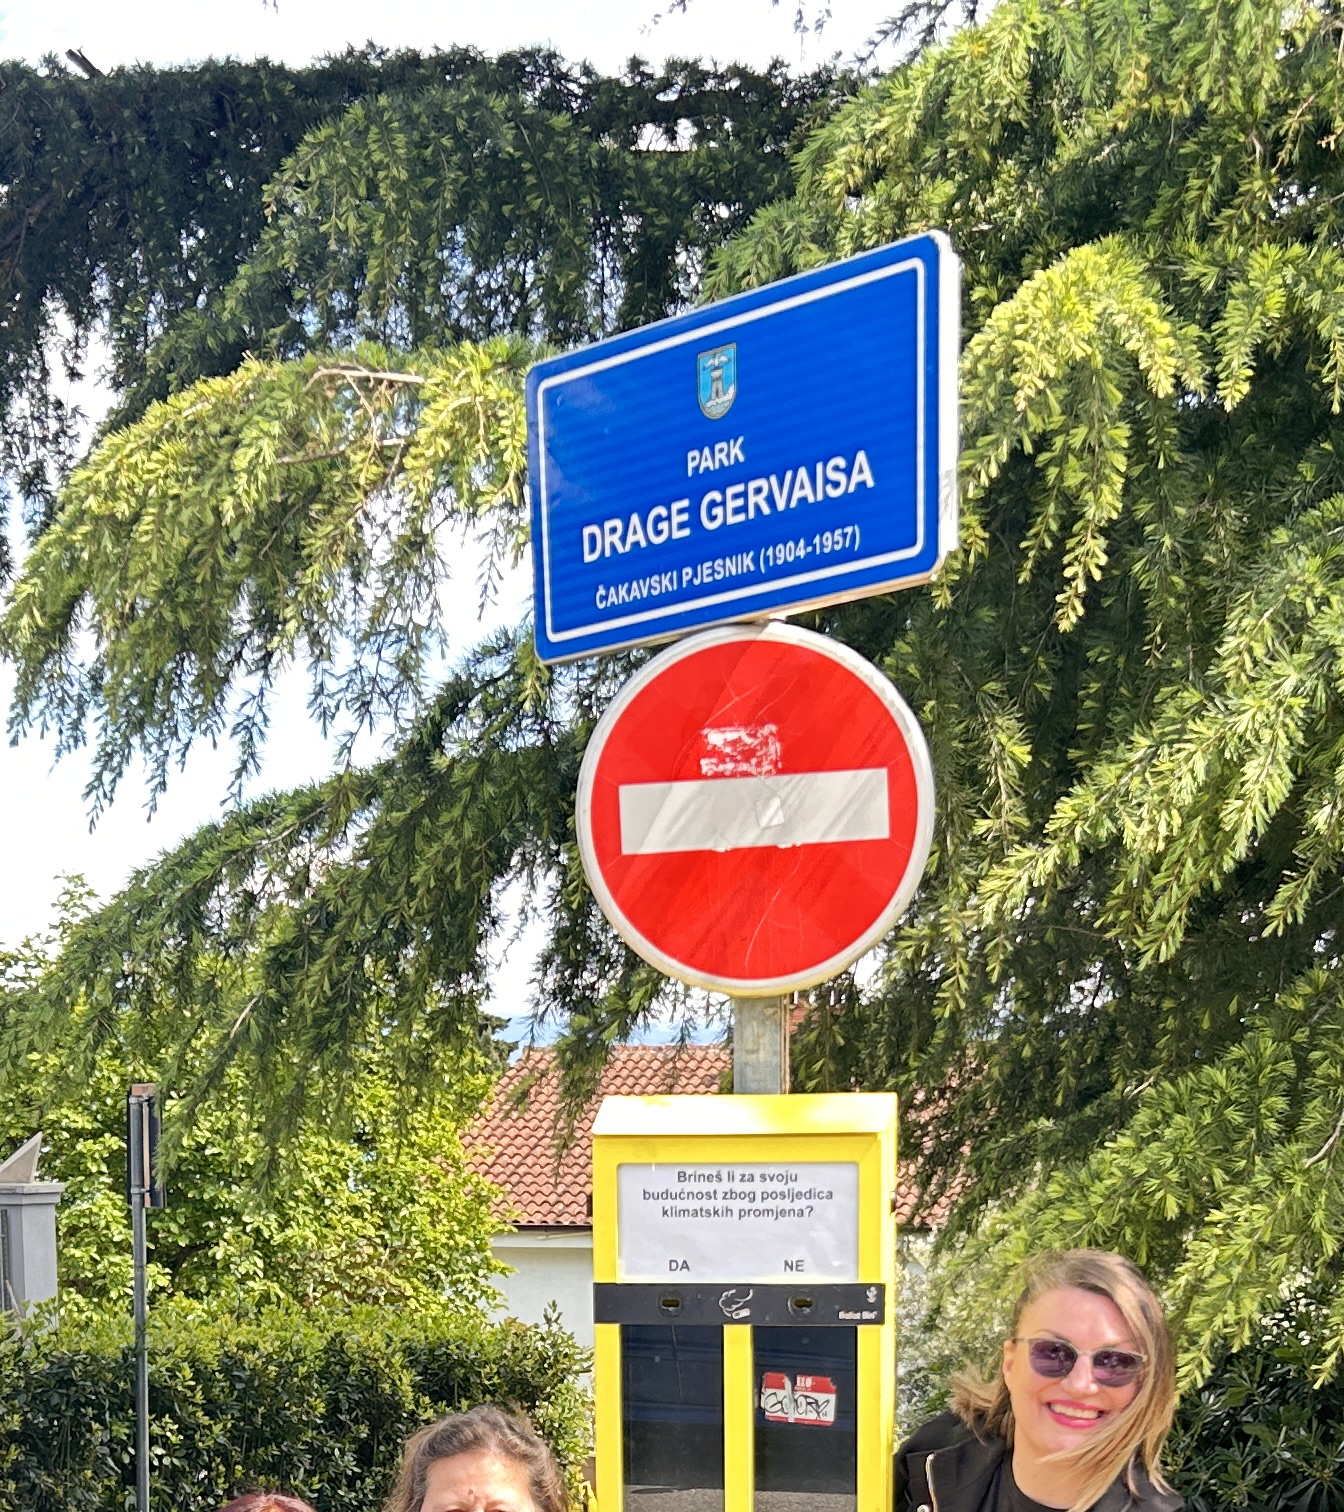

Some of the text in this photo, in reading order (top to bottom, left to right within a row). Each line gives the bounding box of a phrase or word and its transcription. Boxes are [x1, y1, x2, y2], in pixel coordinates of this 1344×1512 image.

[687, 436, 745, 478] PARK
[582, 450, 875, 563] DRAGE GERVAISA
[595, 524, 860, 610] ČAKAVSKI PJESNIK (1904-1957)
[677, 1170, 798, 1187] Brineš li za svoju
[642, 1188, 833, 1204] budućnost zbog posljedica
[661, 1205, 814, 1221] klimatskih promjena?
[668, 1259, 690, 1272] DA
[784, 1259, 804, 1272] NE
